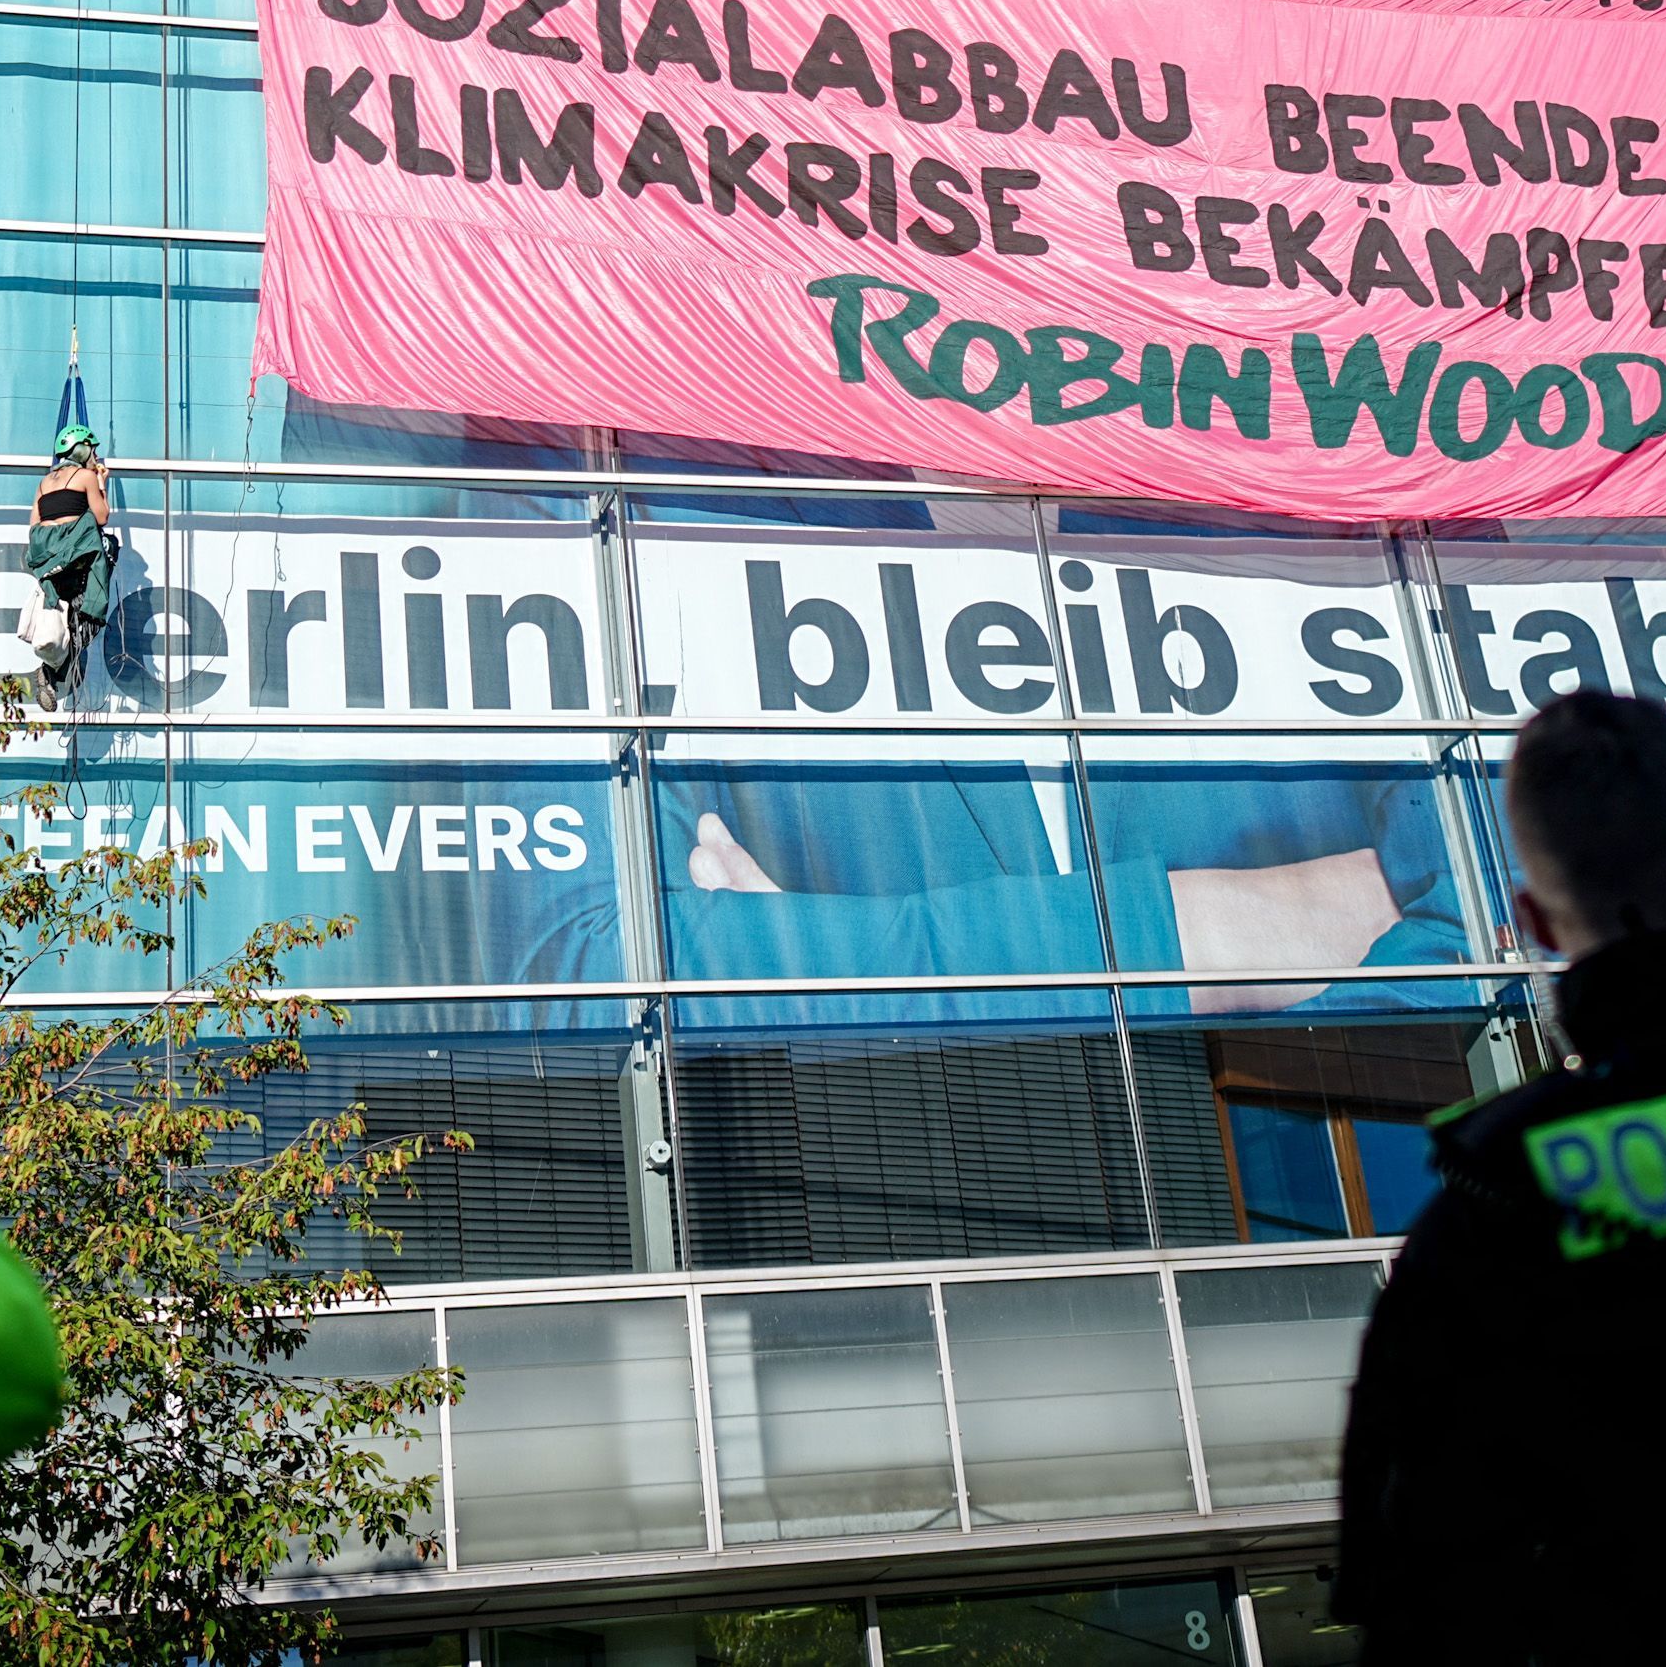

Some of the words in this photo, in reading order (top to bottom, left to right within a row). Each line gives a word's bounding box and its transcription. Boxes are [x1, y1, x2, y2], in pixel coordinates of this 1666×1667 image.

[302, 66, 1050, 257] KLIMAKRISE
[744, 560, 1239, 716] bleib
[294, 804, 588, 872] EVERS
[1185, 1610, 1211, 1651] 8
